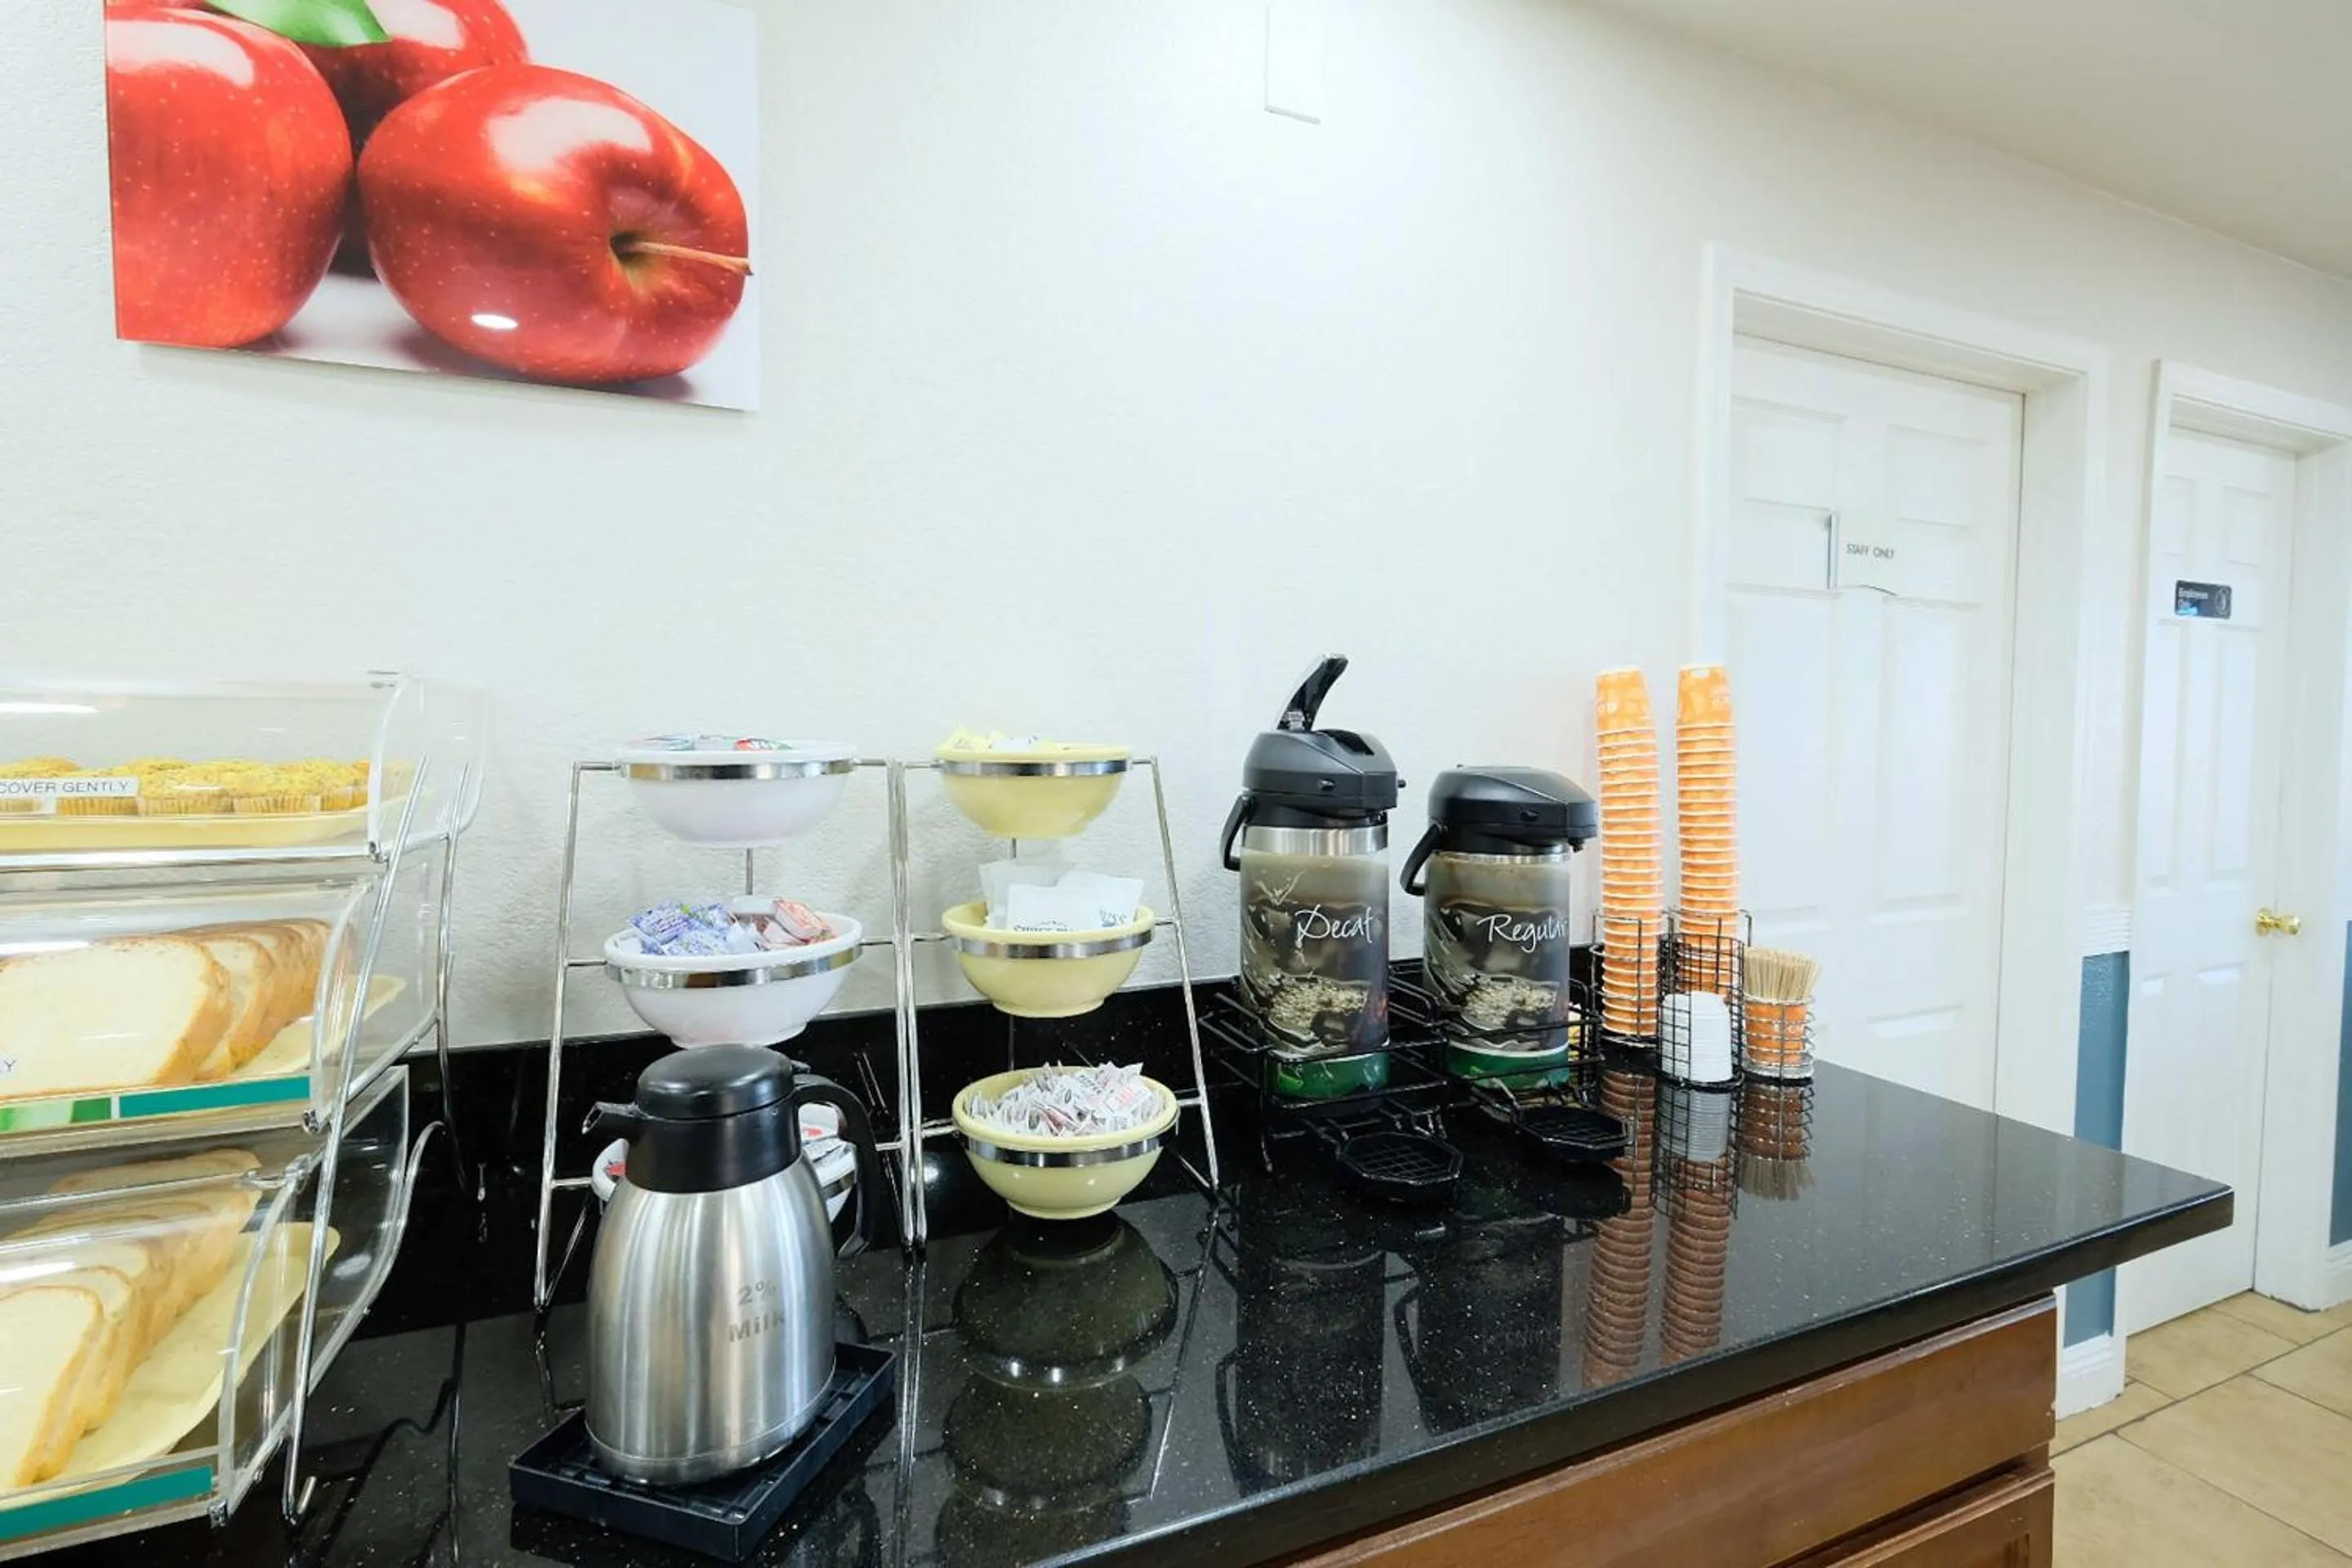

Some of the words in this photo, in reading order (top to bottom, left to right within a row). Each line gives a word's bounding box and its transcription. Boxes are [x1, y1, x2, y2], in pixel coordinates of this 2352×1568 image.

[1873, 546, 1895, 559] ONLY
[62, 781, 128, 793] GENTLY
[1293, 903, 1374, 945] Decaf
[738, 1280, 777, 1305] 2%
[728, 1310, 786, 1343] Milk
